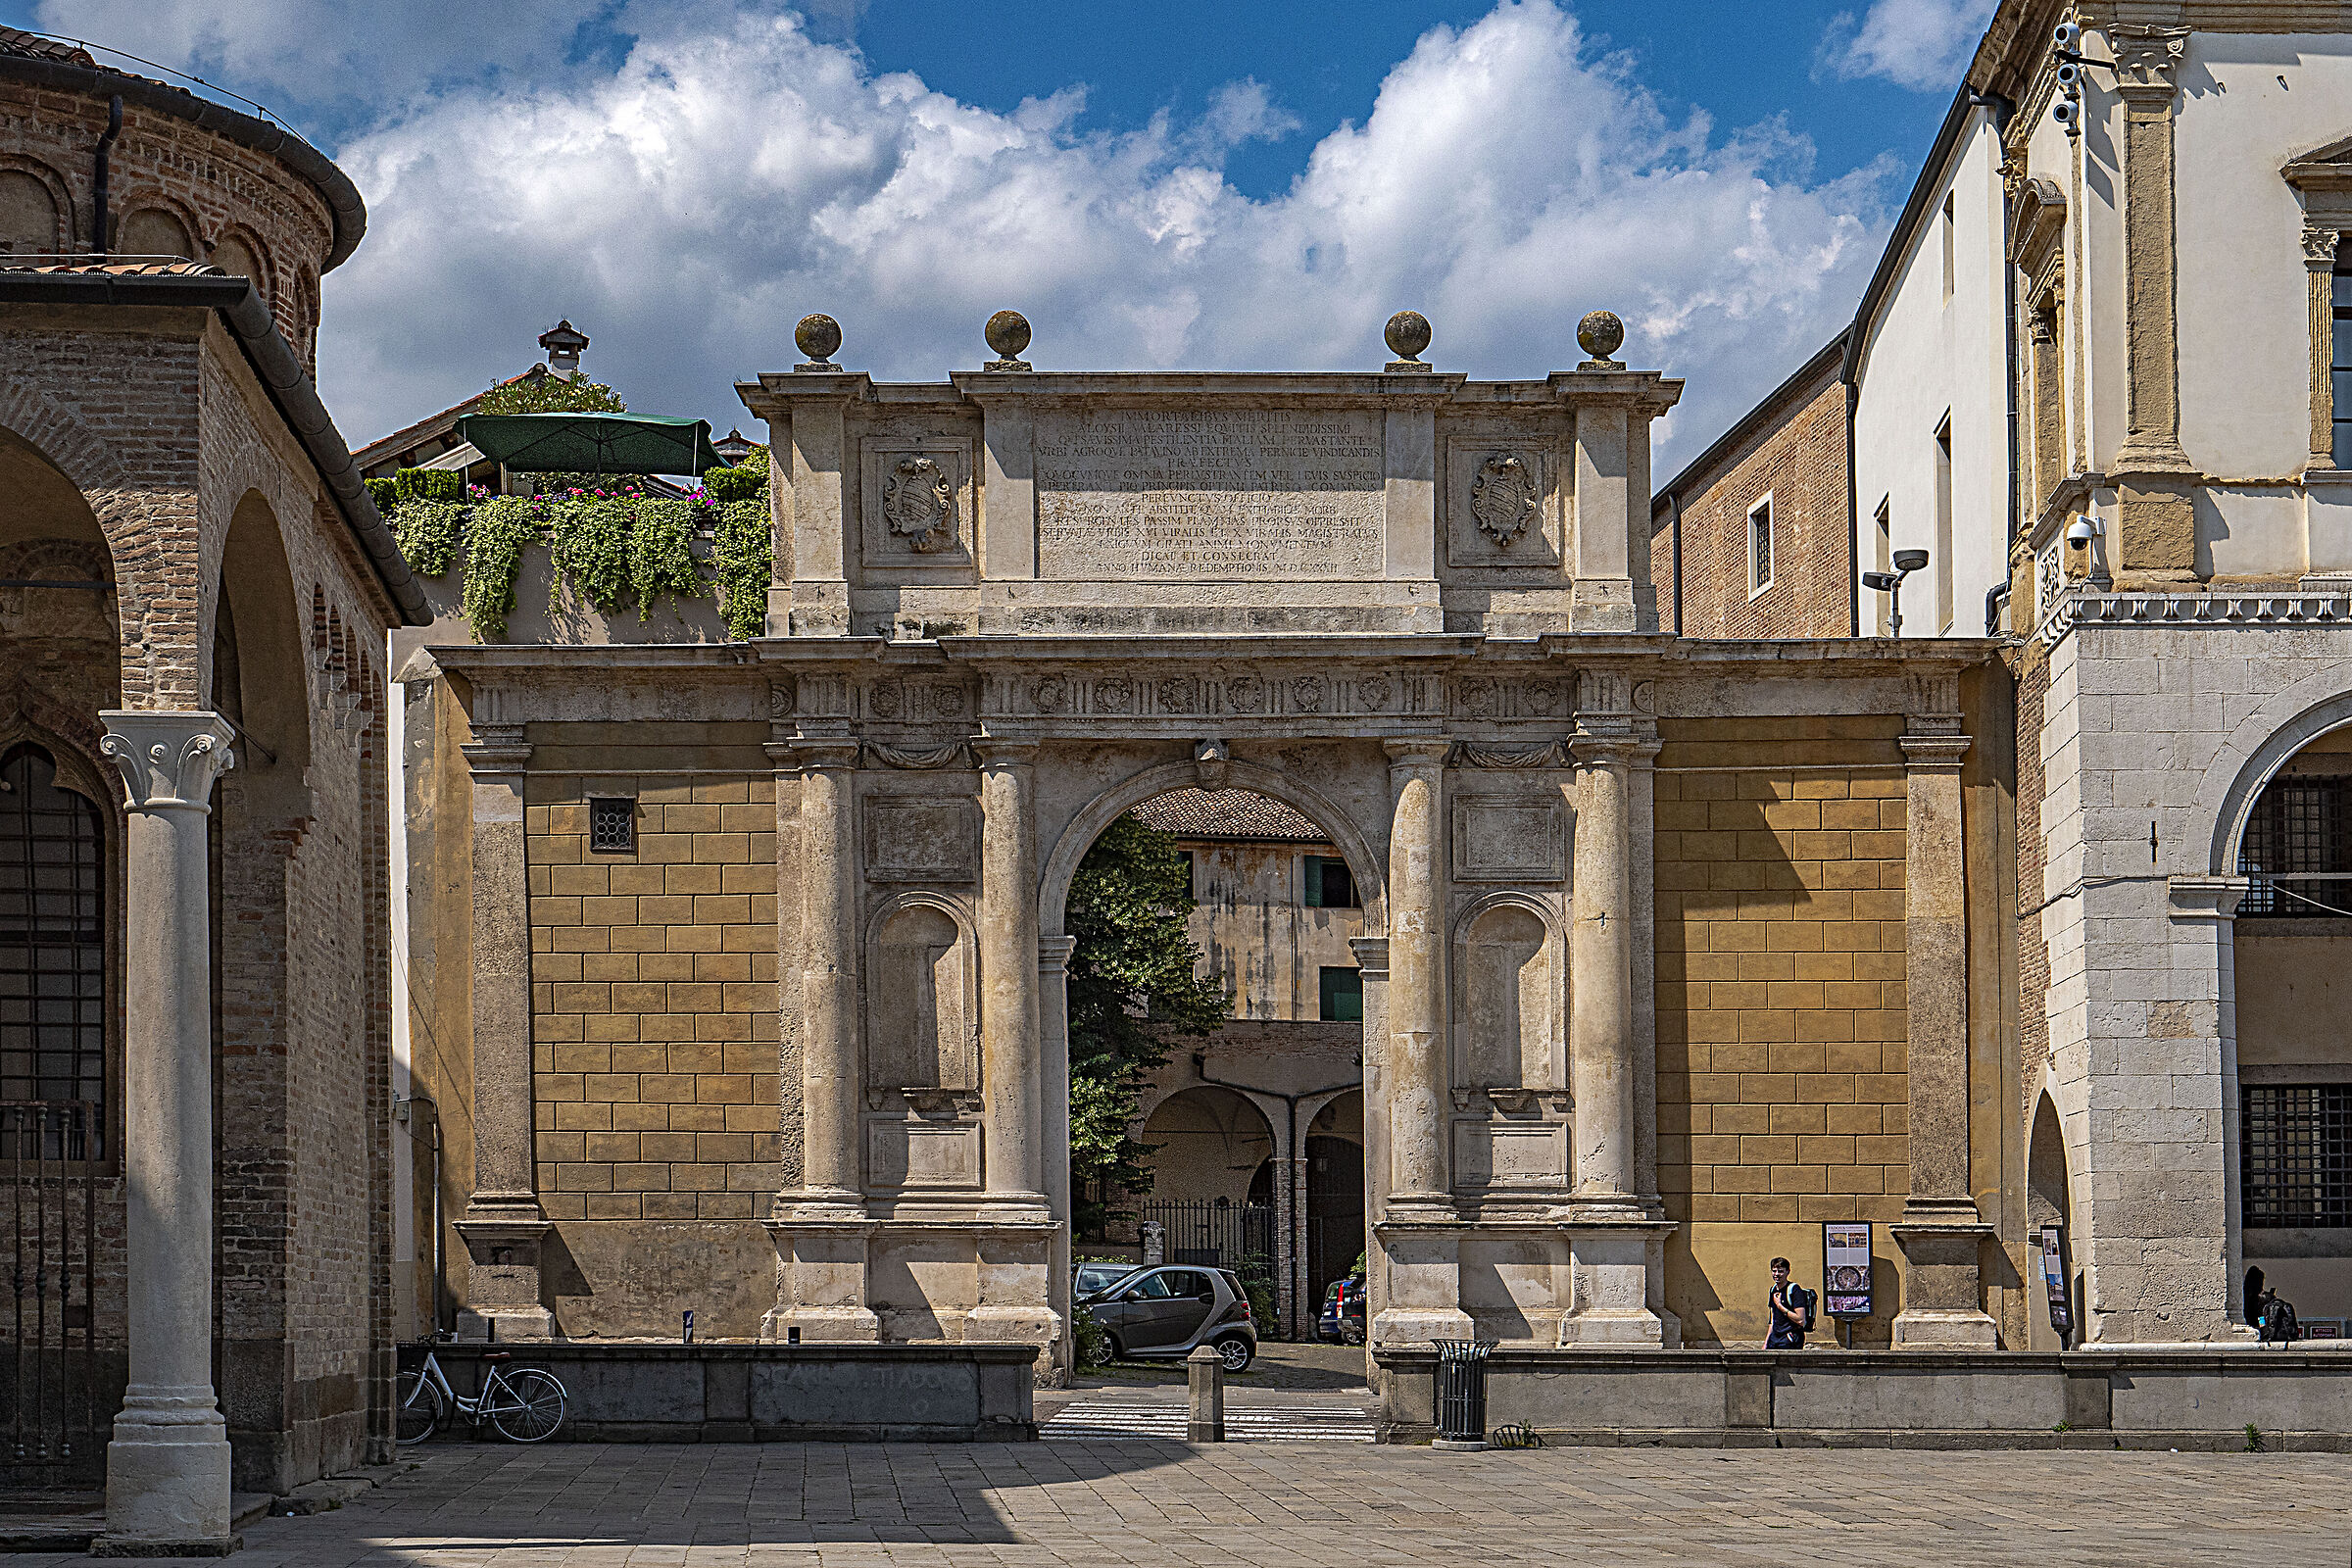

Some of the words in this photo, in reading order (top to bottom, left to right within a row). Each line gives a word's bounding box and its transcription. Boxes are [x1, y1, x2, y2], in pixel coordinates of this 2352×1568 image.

[1235, 412, 1291, 421] MERITIS
[1261, 423, 1350, 434] SPLENDIDISSIMI
[1037, 446, 1067, 457] VRBI
[1073, 447, 1124, 458] AGROQVE
[1260, 447, 1308, 458] PERNICIE
[1312, 447, 1380, 458] VINDICANDIS
[1123, 469, 1163, 480] OMNIA
[1333, 470, 1381, 481] SVSPICIO
[1142, 481, 1195, 492] PRINCIPIS
[1144, 515, 1181, 526] PASSIM
[1183, 551, 1198, 562] ET
[1202, 551, 1277, 562] CONSECRAT
